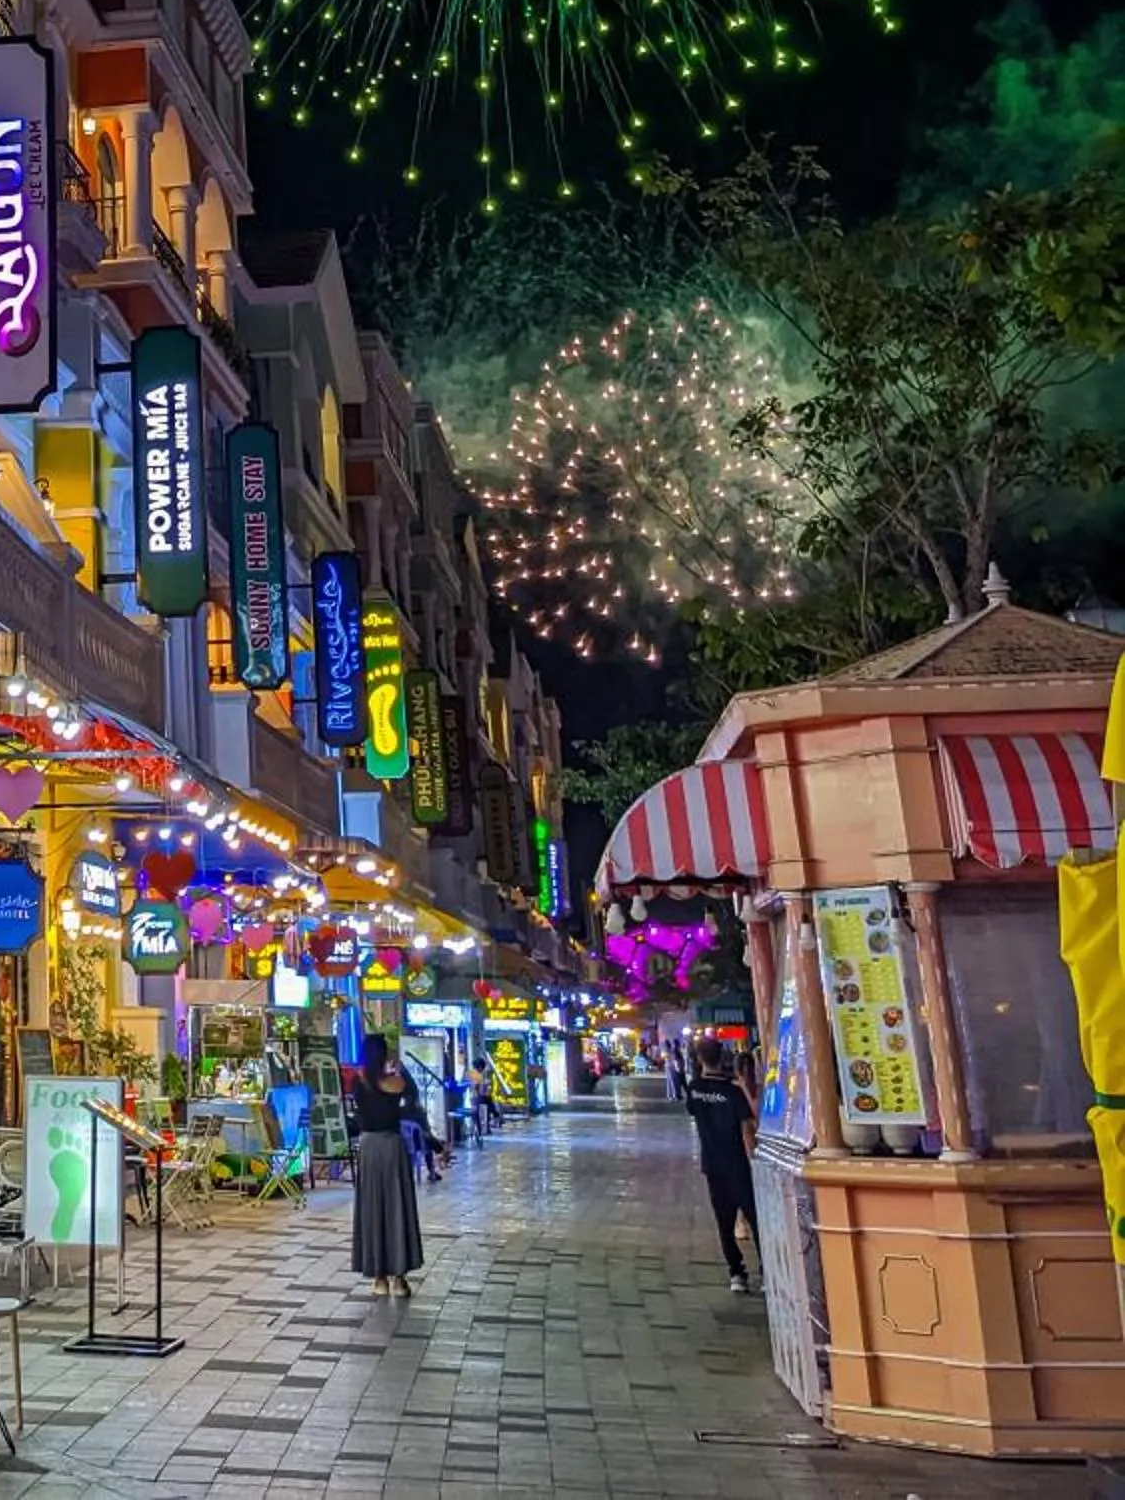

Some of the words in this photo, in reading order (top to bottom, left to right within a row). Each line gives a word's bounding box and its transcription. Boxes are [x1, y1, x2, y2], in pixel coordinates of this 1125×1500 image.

[29, 119, 44, 177] CREAM
[139, 384, 169, 441] MÍA
[173, 383, 188, 410] BAR
[174, 413, 190, 451] JUICE
[147, 448, 173, 552] POWER
[176, 461, 192, 551] SUGARCANE
[242, 455, 266, 503] STAY
[244, 511, 269, 571] HOME
[246, 579, 271, 650] SUNNY
[317, 562, 353, 730] Riverside
